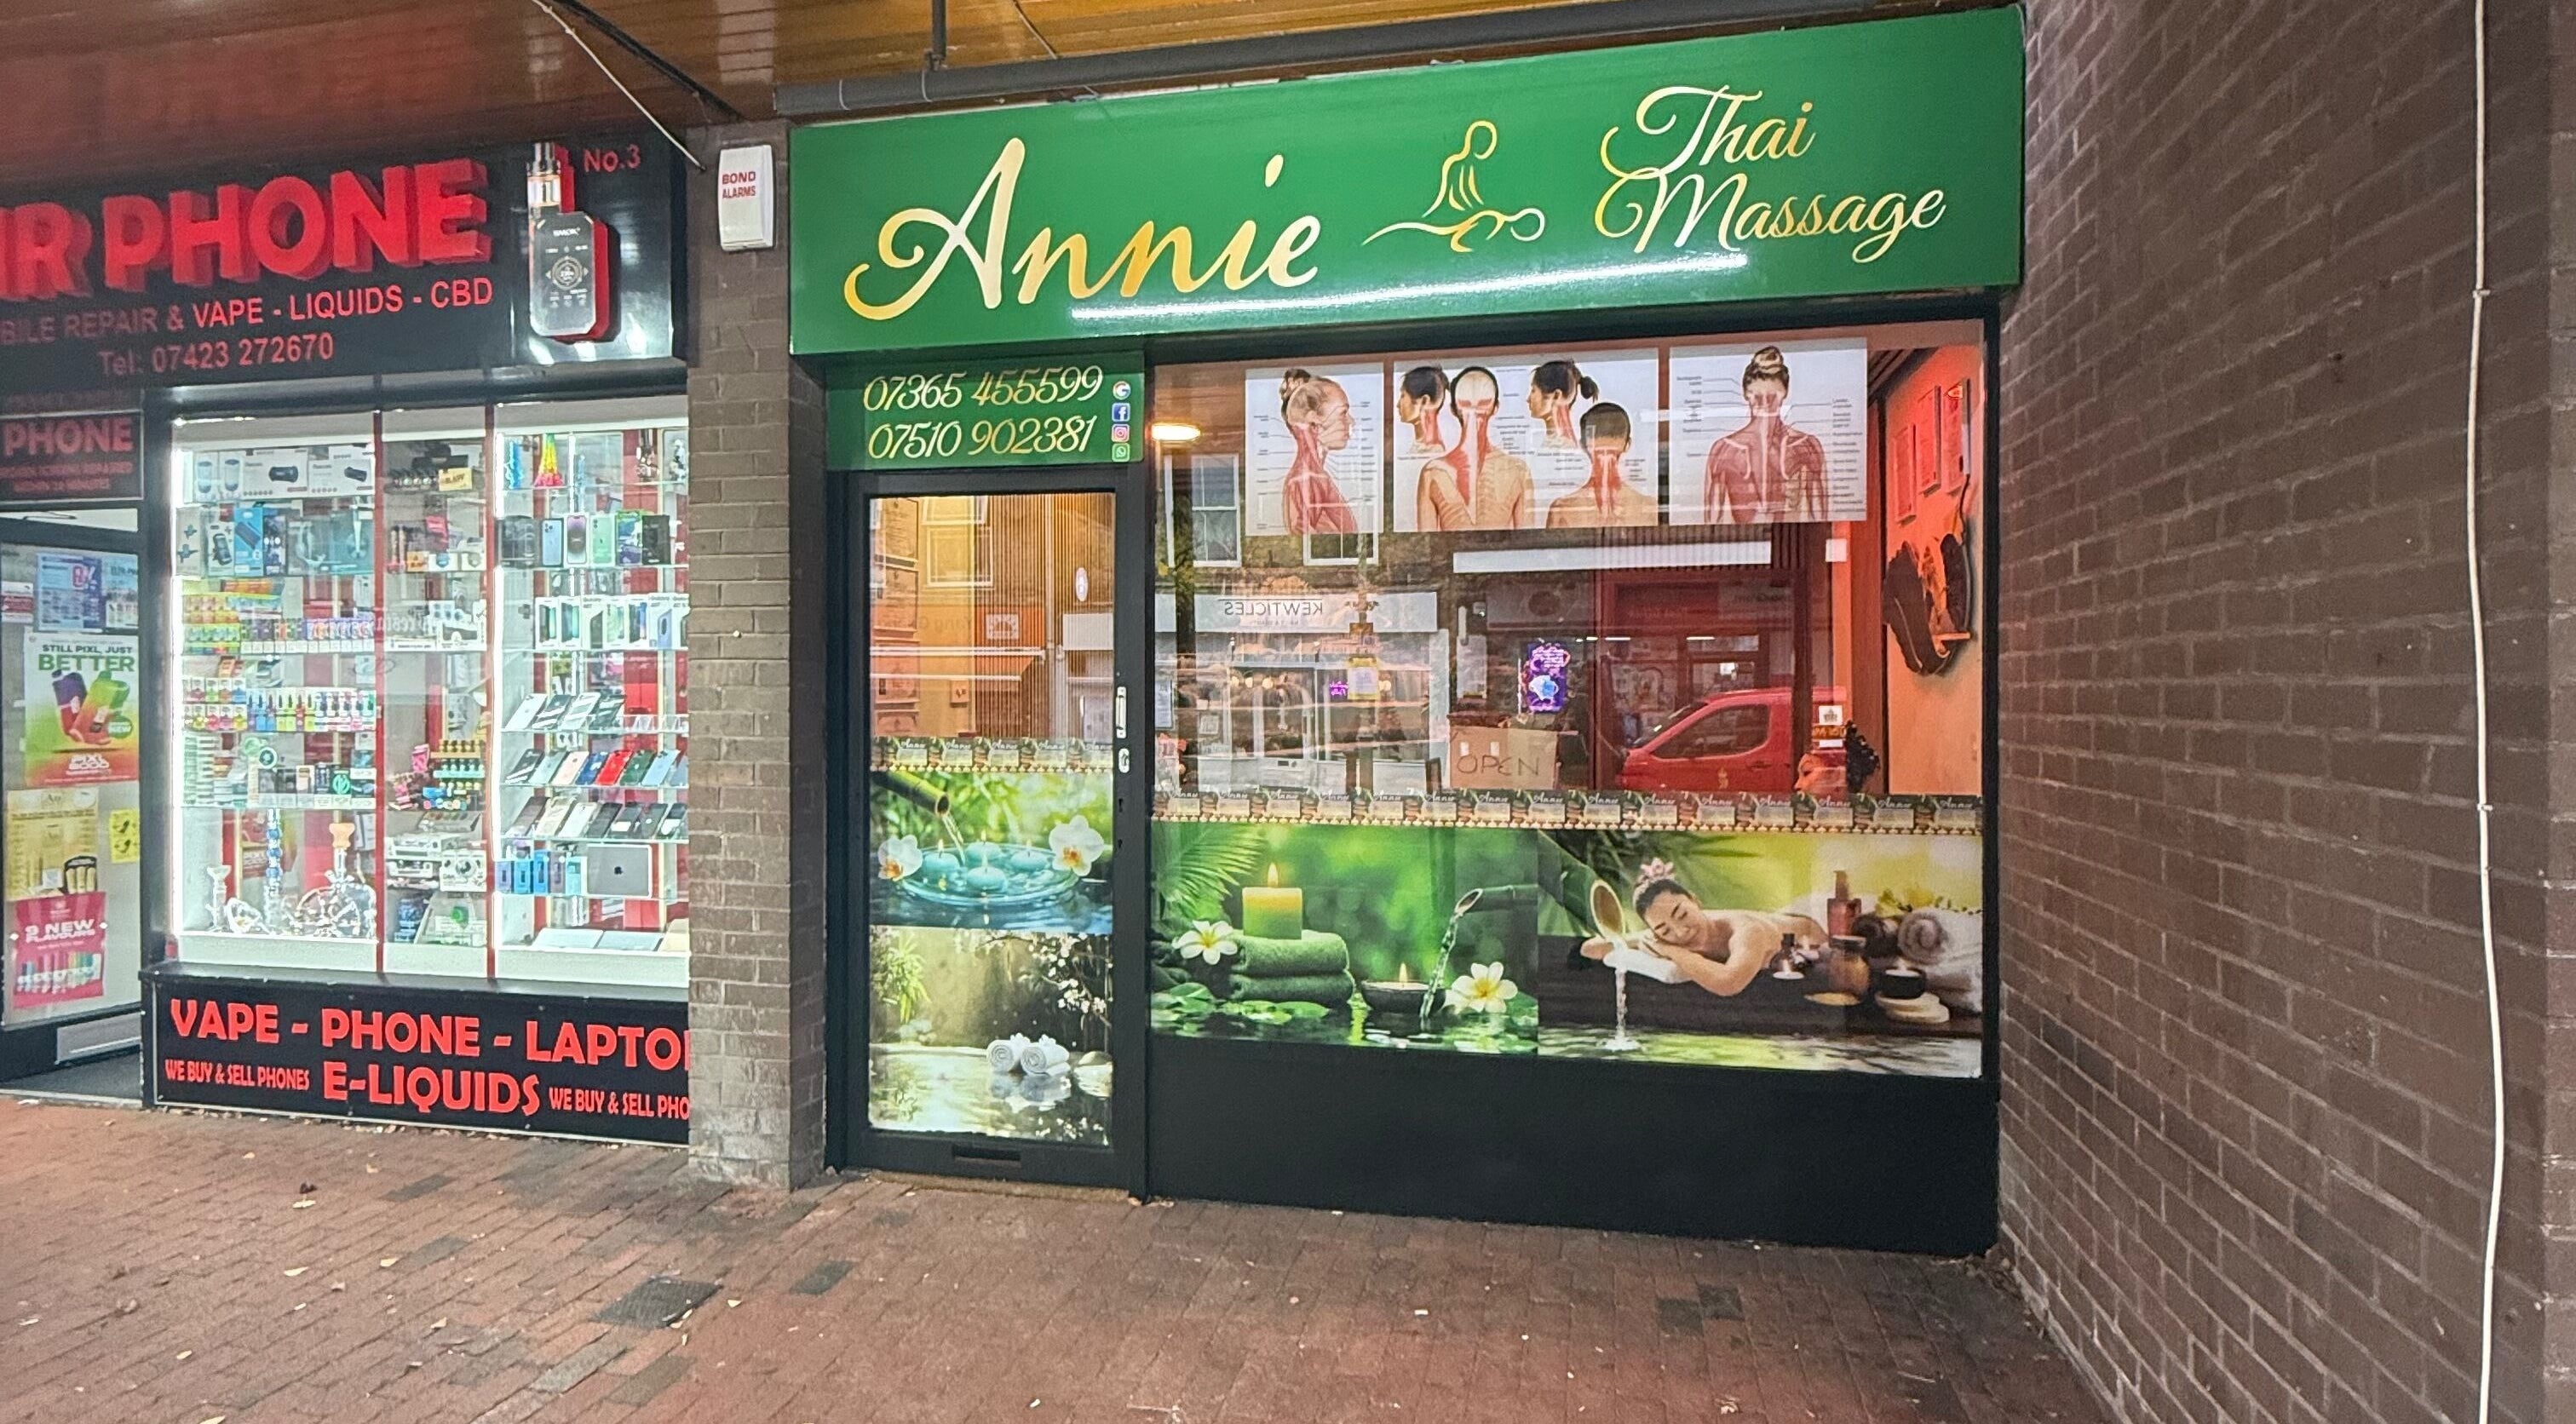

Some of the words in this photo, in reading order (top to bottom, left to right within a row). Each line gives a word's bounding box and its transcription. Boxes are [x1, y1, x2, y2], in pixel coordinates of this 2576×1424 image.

[1600, 84, 1817, 180] Thai
[584, 144, 641, 174] No.3
[722, 171, 756, 185] BOND
[722, 186, 756, 198] ALARMS
[102, 159, 492, 291] PHONE
[844, 137, 1320, 320] Annie
[1595, 167, 1946, 263] Massage
[65, 307, 159, 337] REPAIR
[167, 305, 183, 330] &
[193, 297, 263, 328] VAPE
[290, 284, 404, 320] LIQUIDS
[430, 277, 493, 308] CBD
[151, 341, 229, 372] 07423
[239, 332, 334, 366] 272670
[864, 371, 967, 411] 07365
[971, 365, 1102, 406] 455599
[3, 416, 134, 456] PHONE
[868, 421, 963, 459] 07510
[969, 415, 1097, 456] 902381
[38, 654, 135, 672] BETTER
[1457, 755, 1539, 776] OPEN
[45, 919, 95, 934] NEW
[170, 998, 279, 1043] VAPE
[321, 1008, 480, 1057] PHONE
[164, 1059, 184, 1082] WE
[187, 1061, 213, 1082] BUY
[216, 1064, 225, 1083] &
[227, 1065, 255, 1087] SELL
[258, 1066, 309, 1091] PHONES
[324, 1060, 540, 1116] E-LIQUIDS
[549, 1087, 572, 1111] WE
[575, 1088, 605, 1113] BUY
[608, 1092, 618, 1115] &
[623, 1093, 654, 1117] SELL
